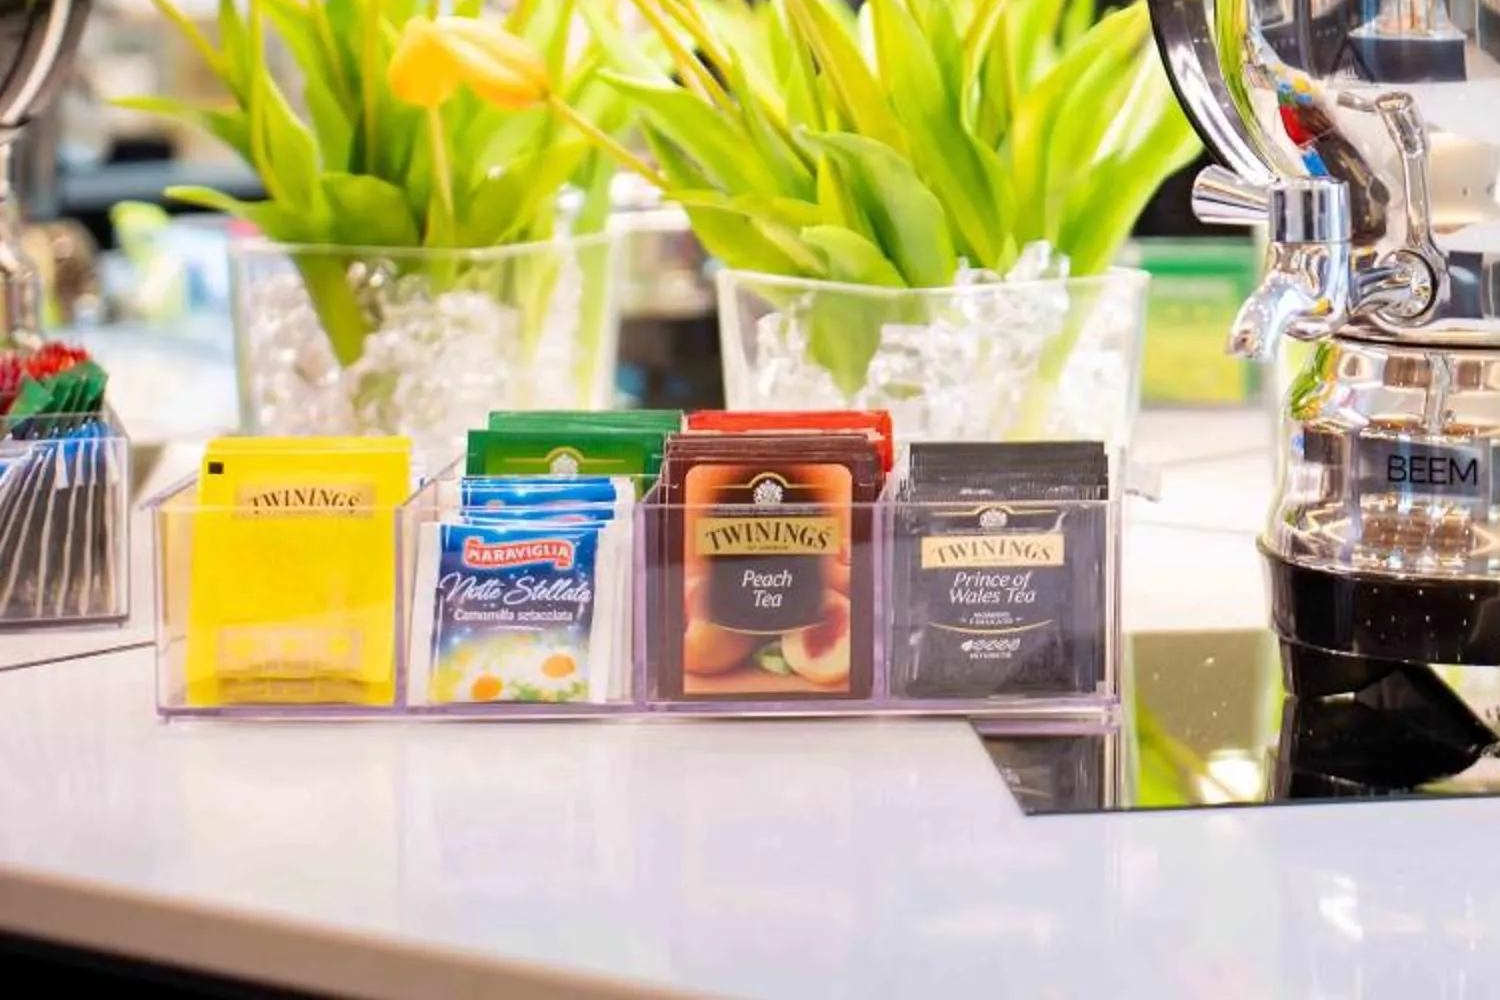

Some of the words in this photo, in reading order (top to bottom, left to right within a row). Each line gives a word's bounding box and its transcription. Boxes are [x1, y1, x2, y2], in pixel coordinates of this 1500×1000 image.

[1386, 454, 1479, 486] BEEM
[249, 487, 361, 515] TWININGS
[705, 521, 832, 550] TWININGS
[467, 543, 570, 563] MARAVIGLIA
[932, 537, 1054, 563] TWININGS
[439, 571, 505, 603] Notte
[503, 575, 592, 605] Stellata
[741, 569, 793, 588] Peach
[953, 570, 1009, 588] Prince
[1012, 570, 1034, 590] of
[752, 589, 783, 608] Tea
[949, 587, 1001, 605] Wales
[1004, 587, 1037, 604] Tea
